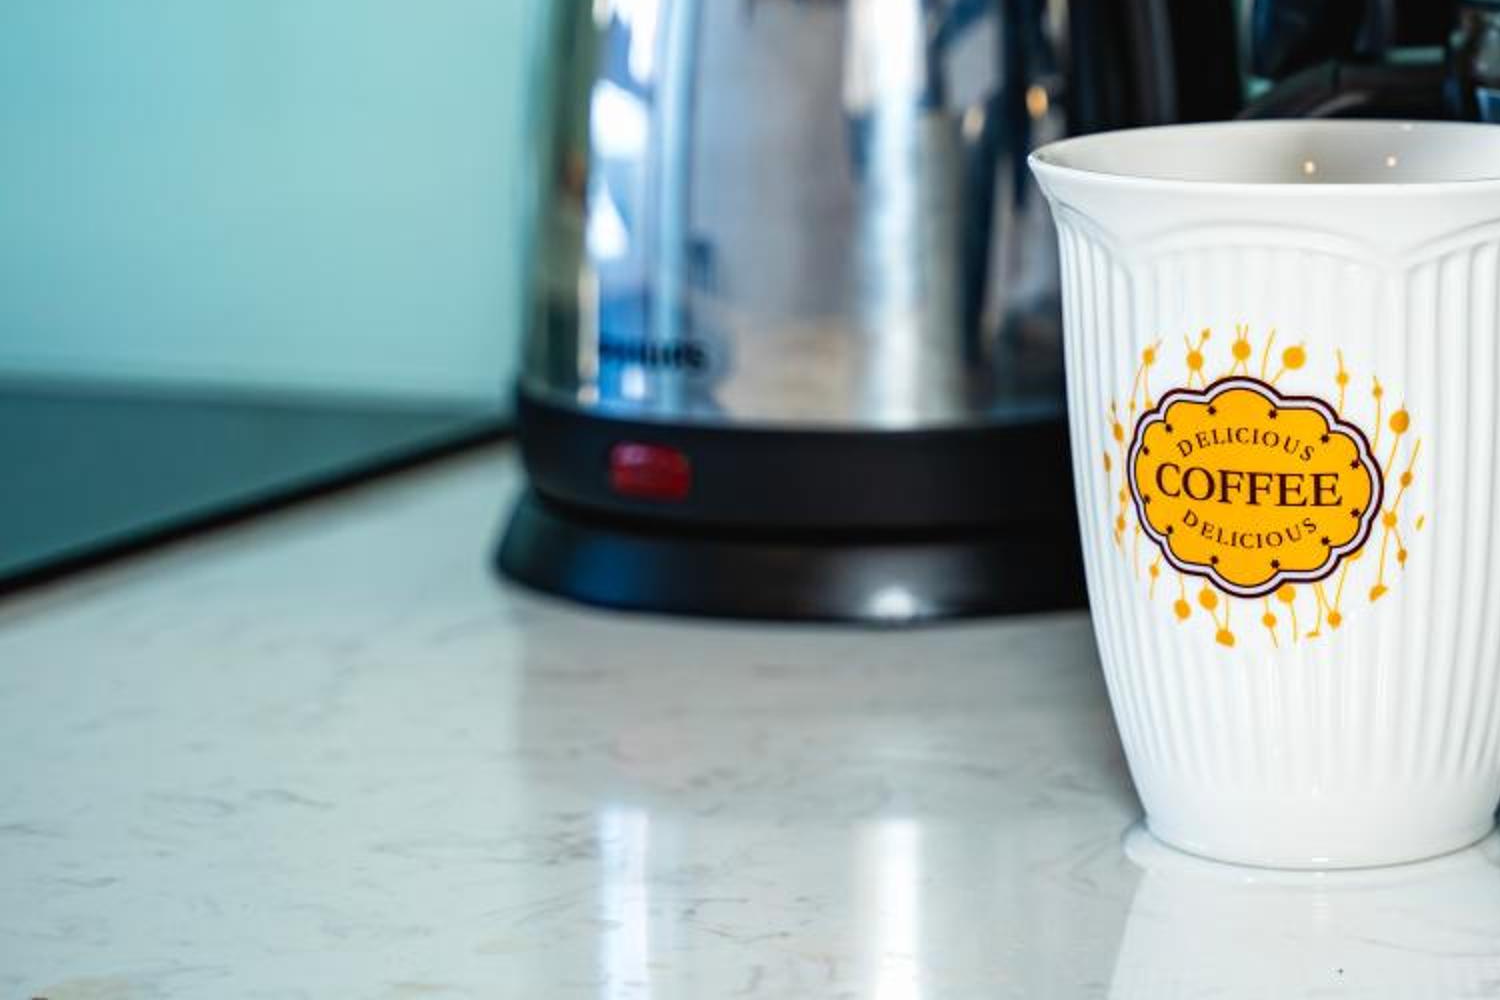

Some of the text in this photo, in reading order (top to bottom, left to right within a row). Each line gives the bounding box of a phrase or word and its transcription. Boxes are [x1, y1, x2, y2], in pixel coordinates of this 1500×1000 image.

[1176, 426, 1316, 462] DELICIOUS
[1155, 462, 1343, 508] COFFEE
[1182, 508, 1318, 550] DELICIOUS
